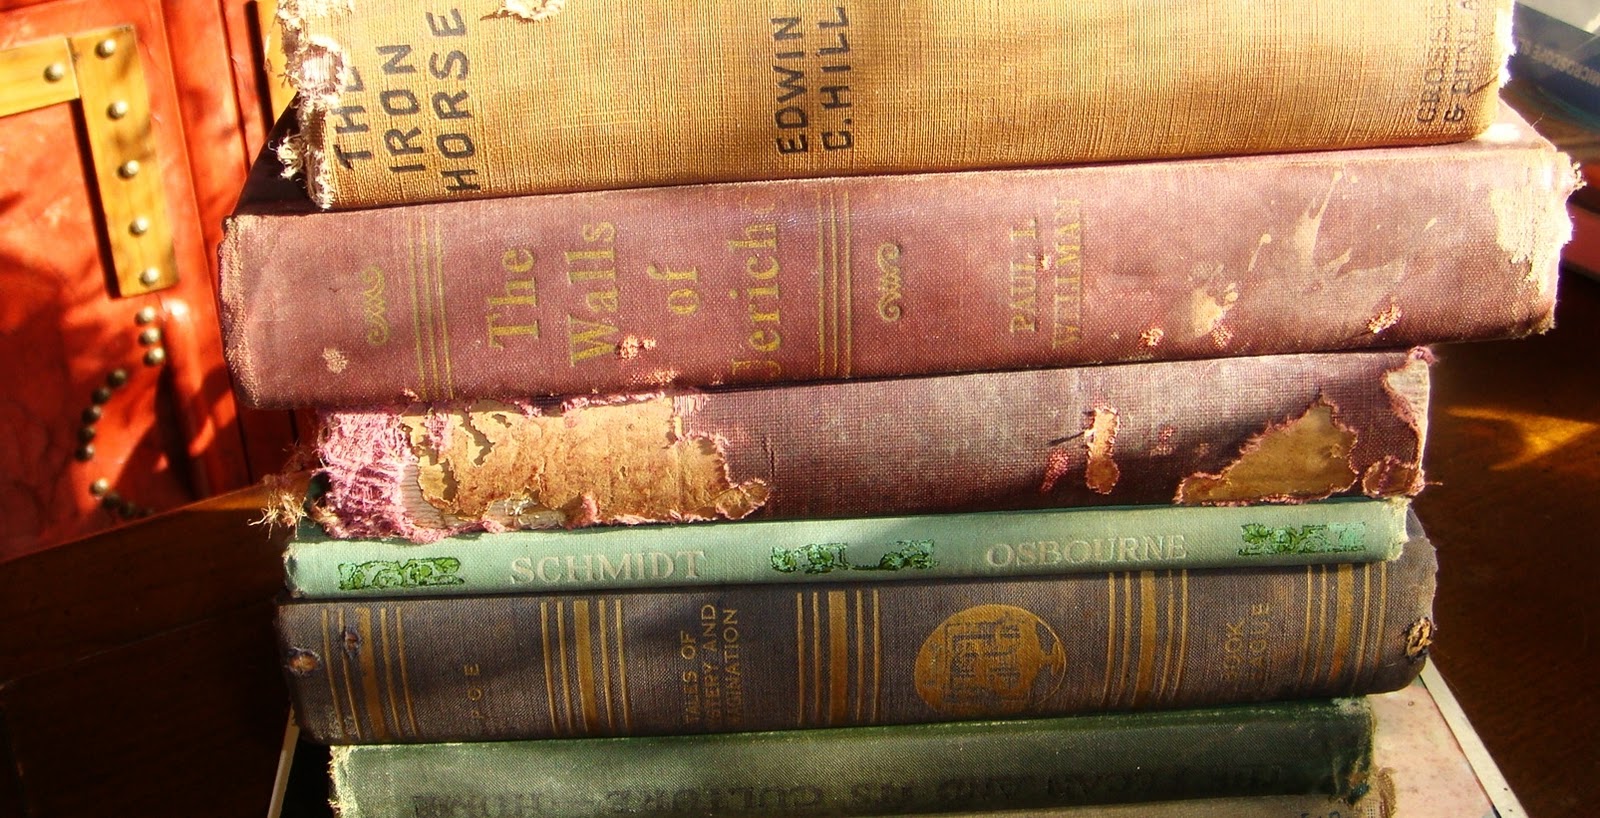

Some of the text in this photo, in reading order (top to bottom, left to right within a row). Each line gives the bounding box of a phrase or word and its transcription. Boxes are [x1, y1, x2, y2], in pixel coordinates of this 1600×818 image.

[376, 44, 426, 173] IRON
[426, 8, 482, 191] HORSE
[770, 16, 808, 155] EDWIN
[1417, 0, 1451, 122] GROSSE
[1444, 0, 1482, 122] & DUNLA
[489, 246, 540, 350] The
[564, 220, 621, 367] Walls
[647, 264, 699, 316] of
[1009, 252, 1037, 334] PAUL
[1053, 198, 1082, 349] WELLMAN
[510, 550, 706, 586] SCHMIDT
[986, 534, 1188, 568] OSBOURNE
[464, 662, 485, 720] POE
[680, 629, 700, 723] TALES OF
[700, 604, 722, 725] YSTERY AND
[722, 608, 742, 725] AGINATION
[1247, 602, 1272, 683] EAGUE
